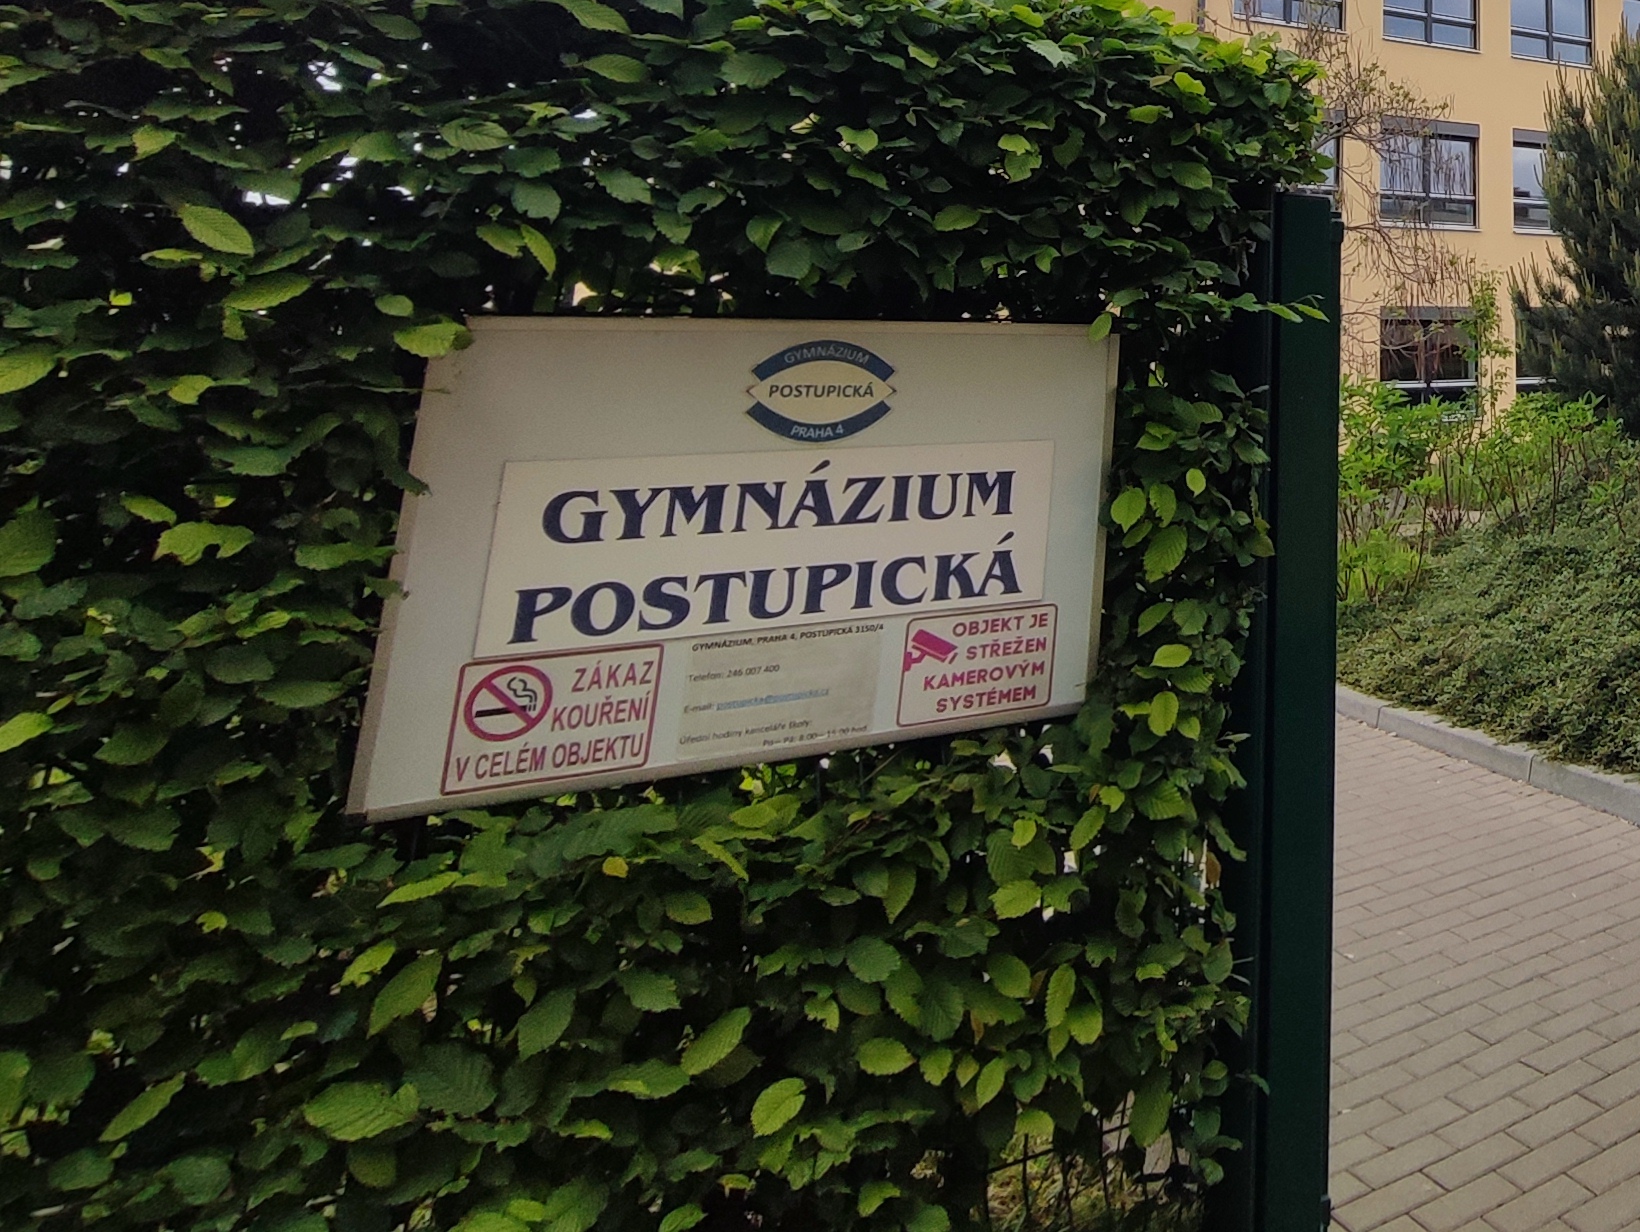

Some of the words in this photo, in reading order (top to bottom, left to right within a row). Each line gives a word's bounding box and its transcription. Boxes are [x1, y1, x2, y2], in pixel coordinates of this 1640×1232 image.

[784, 344, 870, 365] GYMNÁZIUM
[768, 381, 874, 398] POSTUPICKÁ
[790, 425, 833, 438] PRAHA
[835, 424, 844, 434] 4
[541, 460, 1016, 544] GYMNÁZIUM
[506, 531, 1023, 645] POSTUPICKÁ
[691, 637, 754, 652] GYMNÁZIUM,
[756, 633, 788, 644] PRAHA
[800, 625, 854, 639] POSTUPICKÁ
[952, 615, 1025, 637] OBJEKT
[1029, 613, 1049, 629] JE
[966, 636, 1047, 660] STŘEŽEN
[571, 660, 654, 693] ZÁKAZ
[923, 659, 1045, 691] KAMEROVÝM
[551, 691, 651, 732] KOUŘENÍ
[936, 685, 1037, 713] SYSTÉMEM
[456, 756, 471, 782] V
[475, 742, 547, 779] CELÉM
[552, 733, 644, 768] OBJEKTU
